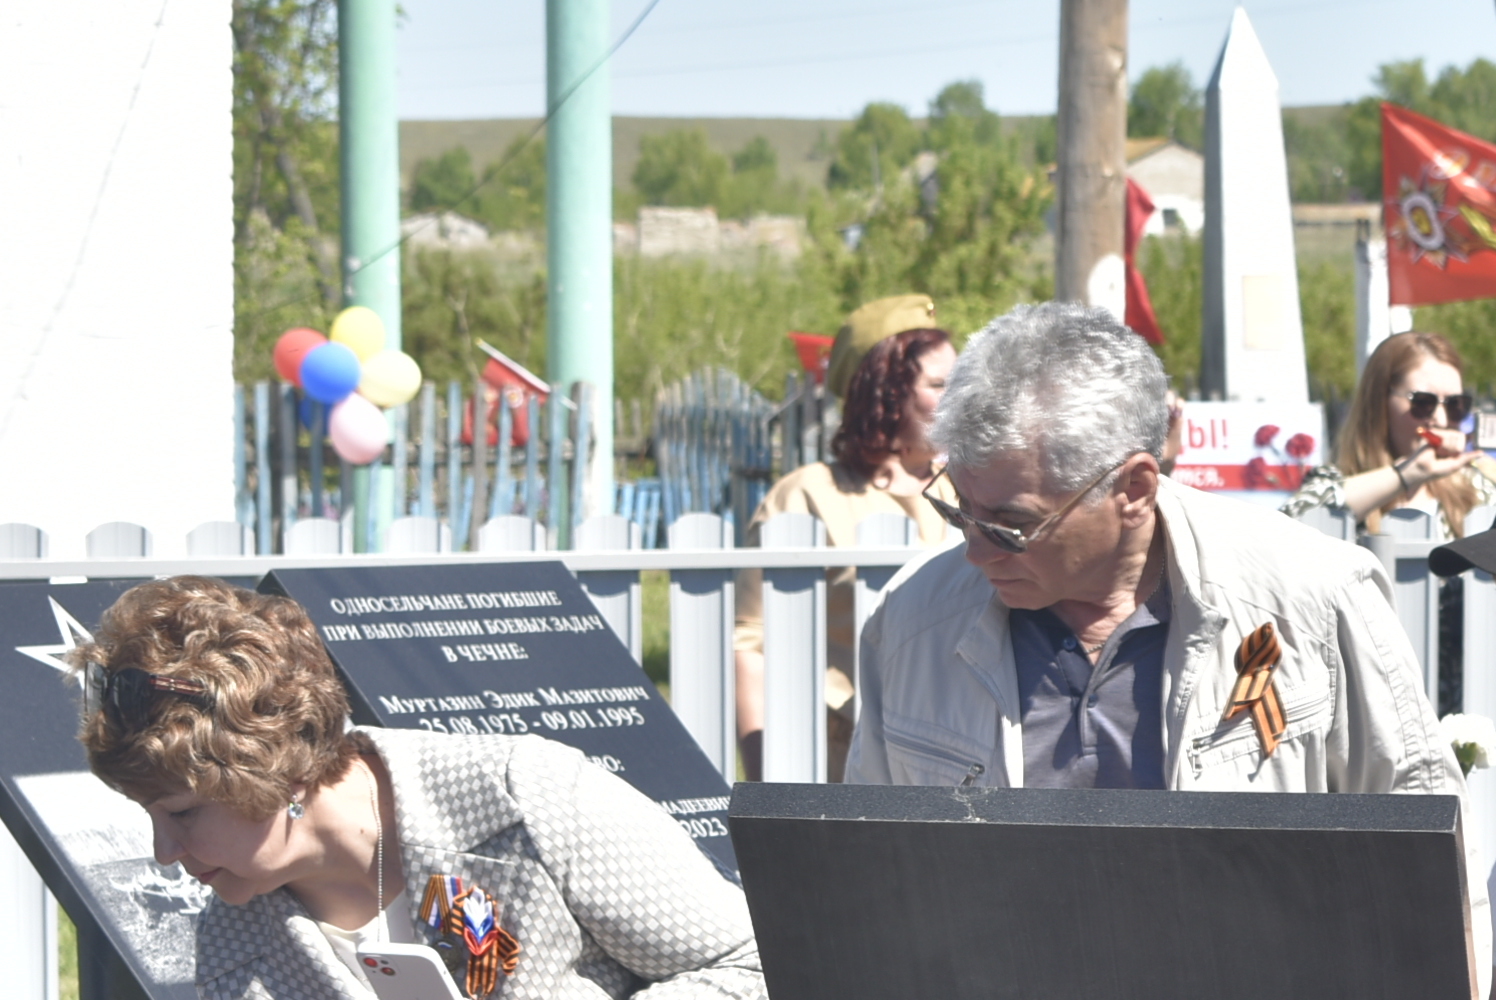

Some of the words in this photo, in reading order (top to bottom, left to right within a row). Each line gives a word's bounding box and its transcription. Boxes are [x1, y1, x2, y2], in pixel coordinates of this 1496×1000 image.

[1179, 418, 1229, 455] Ы!
[330, 594, 468, 616] ОДНОСЕЛЬЧАНЕ
[466, 590, 562, 610] ПОГИБШИЕ
[322, 624, 362, 641] ПРИ
[361, 619, 485, 640] ВЫПОЛНЕНИИ
[484, 616, 553, 635] БОЕВЫХ
[550, 614, 605, 634] ЗАДАЧ
[441, 646, 459, 663] В
[456, 642, 529, 662] ЧЕЧНЕ:
[419, 713, 528, 735] 2508.1975
[540, 707, 645, 730] 09.01.1995
